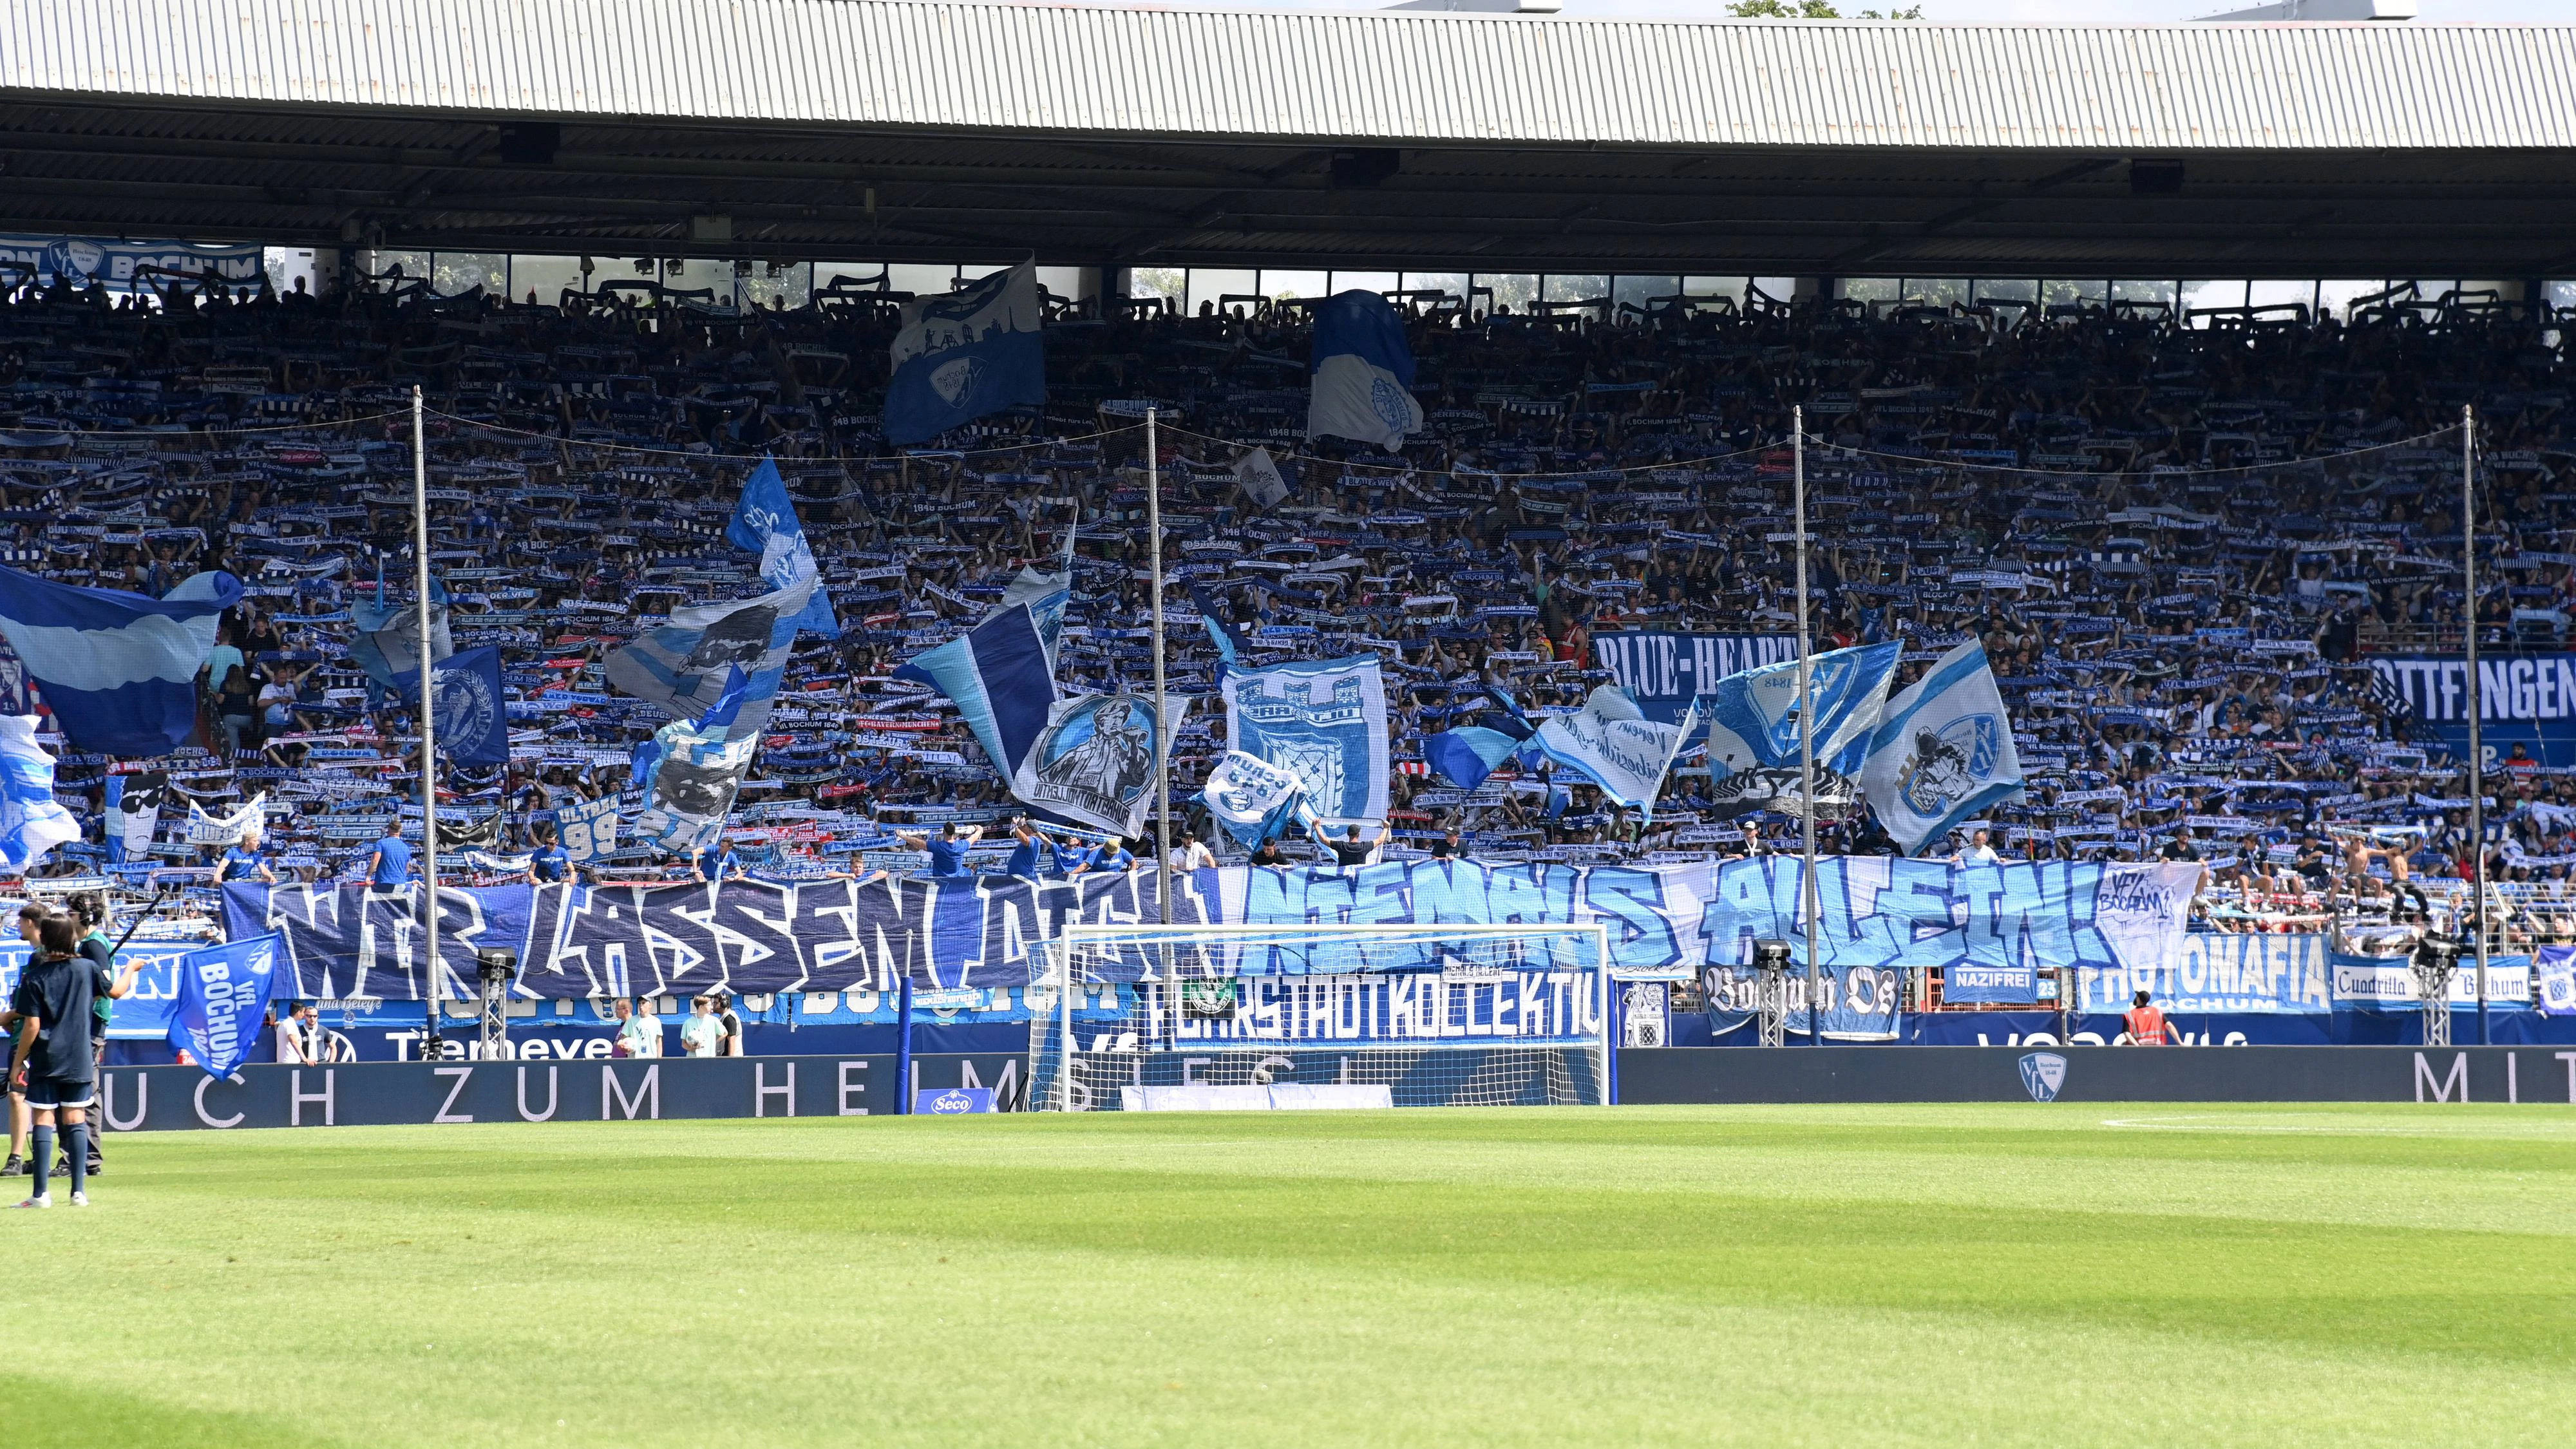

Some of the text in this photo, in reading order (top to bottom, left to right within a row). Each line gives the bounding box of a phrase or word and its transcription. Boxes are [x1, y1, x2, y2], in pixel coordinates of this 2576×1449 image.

[111, 254, 256, 279] BOCHUM
[1269, 429, 1289, 437] 1848
[1451, 424, 1483, 432] BOCHUM
[262, 464, 292, 473] Bochum
[2061, 520, 2094, 528] BOCHUM
[1863, 585, 1894, 593] BOCHUM
[2322, 713, 2362, 723] BOCHUM
[558, 794, 618, 824] ULTRAS
[564, 812, 618, 861] 99
[2098, 891, 2174, 920] BOCHUM!
[267, 882, 485, 1000] WIR
[513, 877, 943, 999] LASSEN
[1240, 860, 1684, 976] NIEMALS
[1698, 855, 2117, 967] ALLEIN!
[1955, 972, 2031, 989] NAZIFREI
[2338, 971, 2525, 996] Cuadrilla Bchum
[2038, 982, 2057, 998] 23
[2150, 998, 2277, 1010] OCHUM
[199, 961, 239, 1070] BOCHUM
[103, 1070, 335, 1132] UCH
[433, 1065, 659, 1124] ZUM
[934, 1099, 969, 1111] Seco
